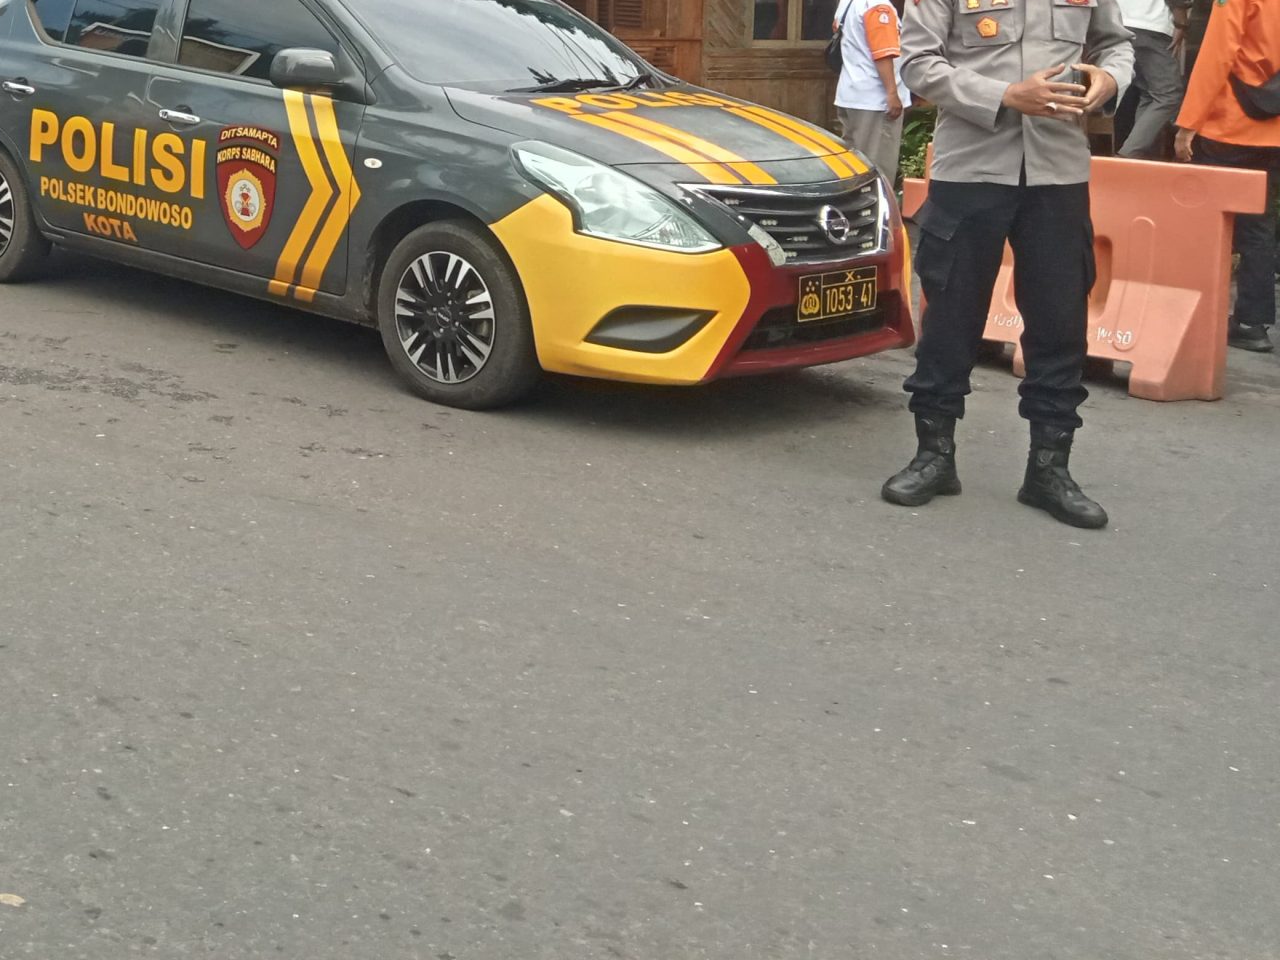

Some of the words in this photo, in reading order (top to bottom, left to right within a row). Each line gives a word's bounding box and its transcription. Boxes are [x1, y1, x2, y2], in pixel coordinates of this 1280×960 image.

[221, 127, 277, 149] DITSAMAPTA
[29, 108, 207, 199] POLISI
[217, 147, 241, 164] KORPS
[242, 147, 276, 174] SABHARA
[40, 176, 96, 208] POLSEK
[97, 188, 193, 230] BONDOWOSO
[83, 212, 138, 242] KOTA
